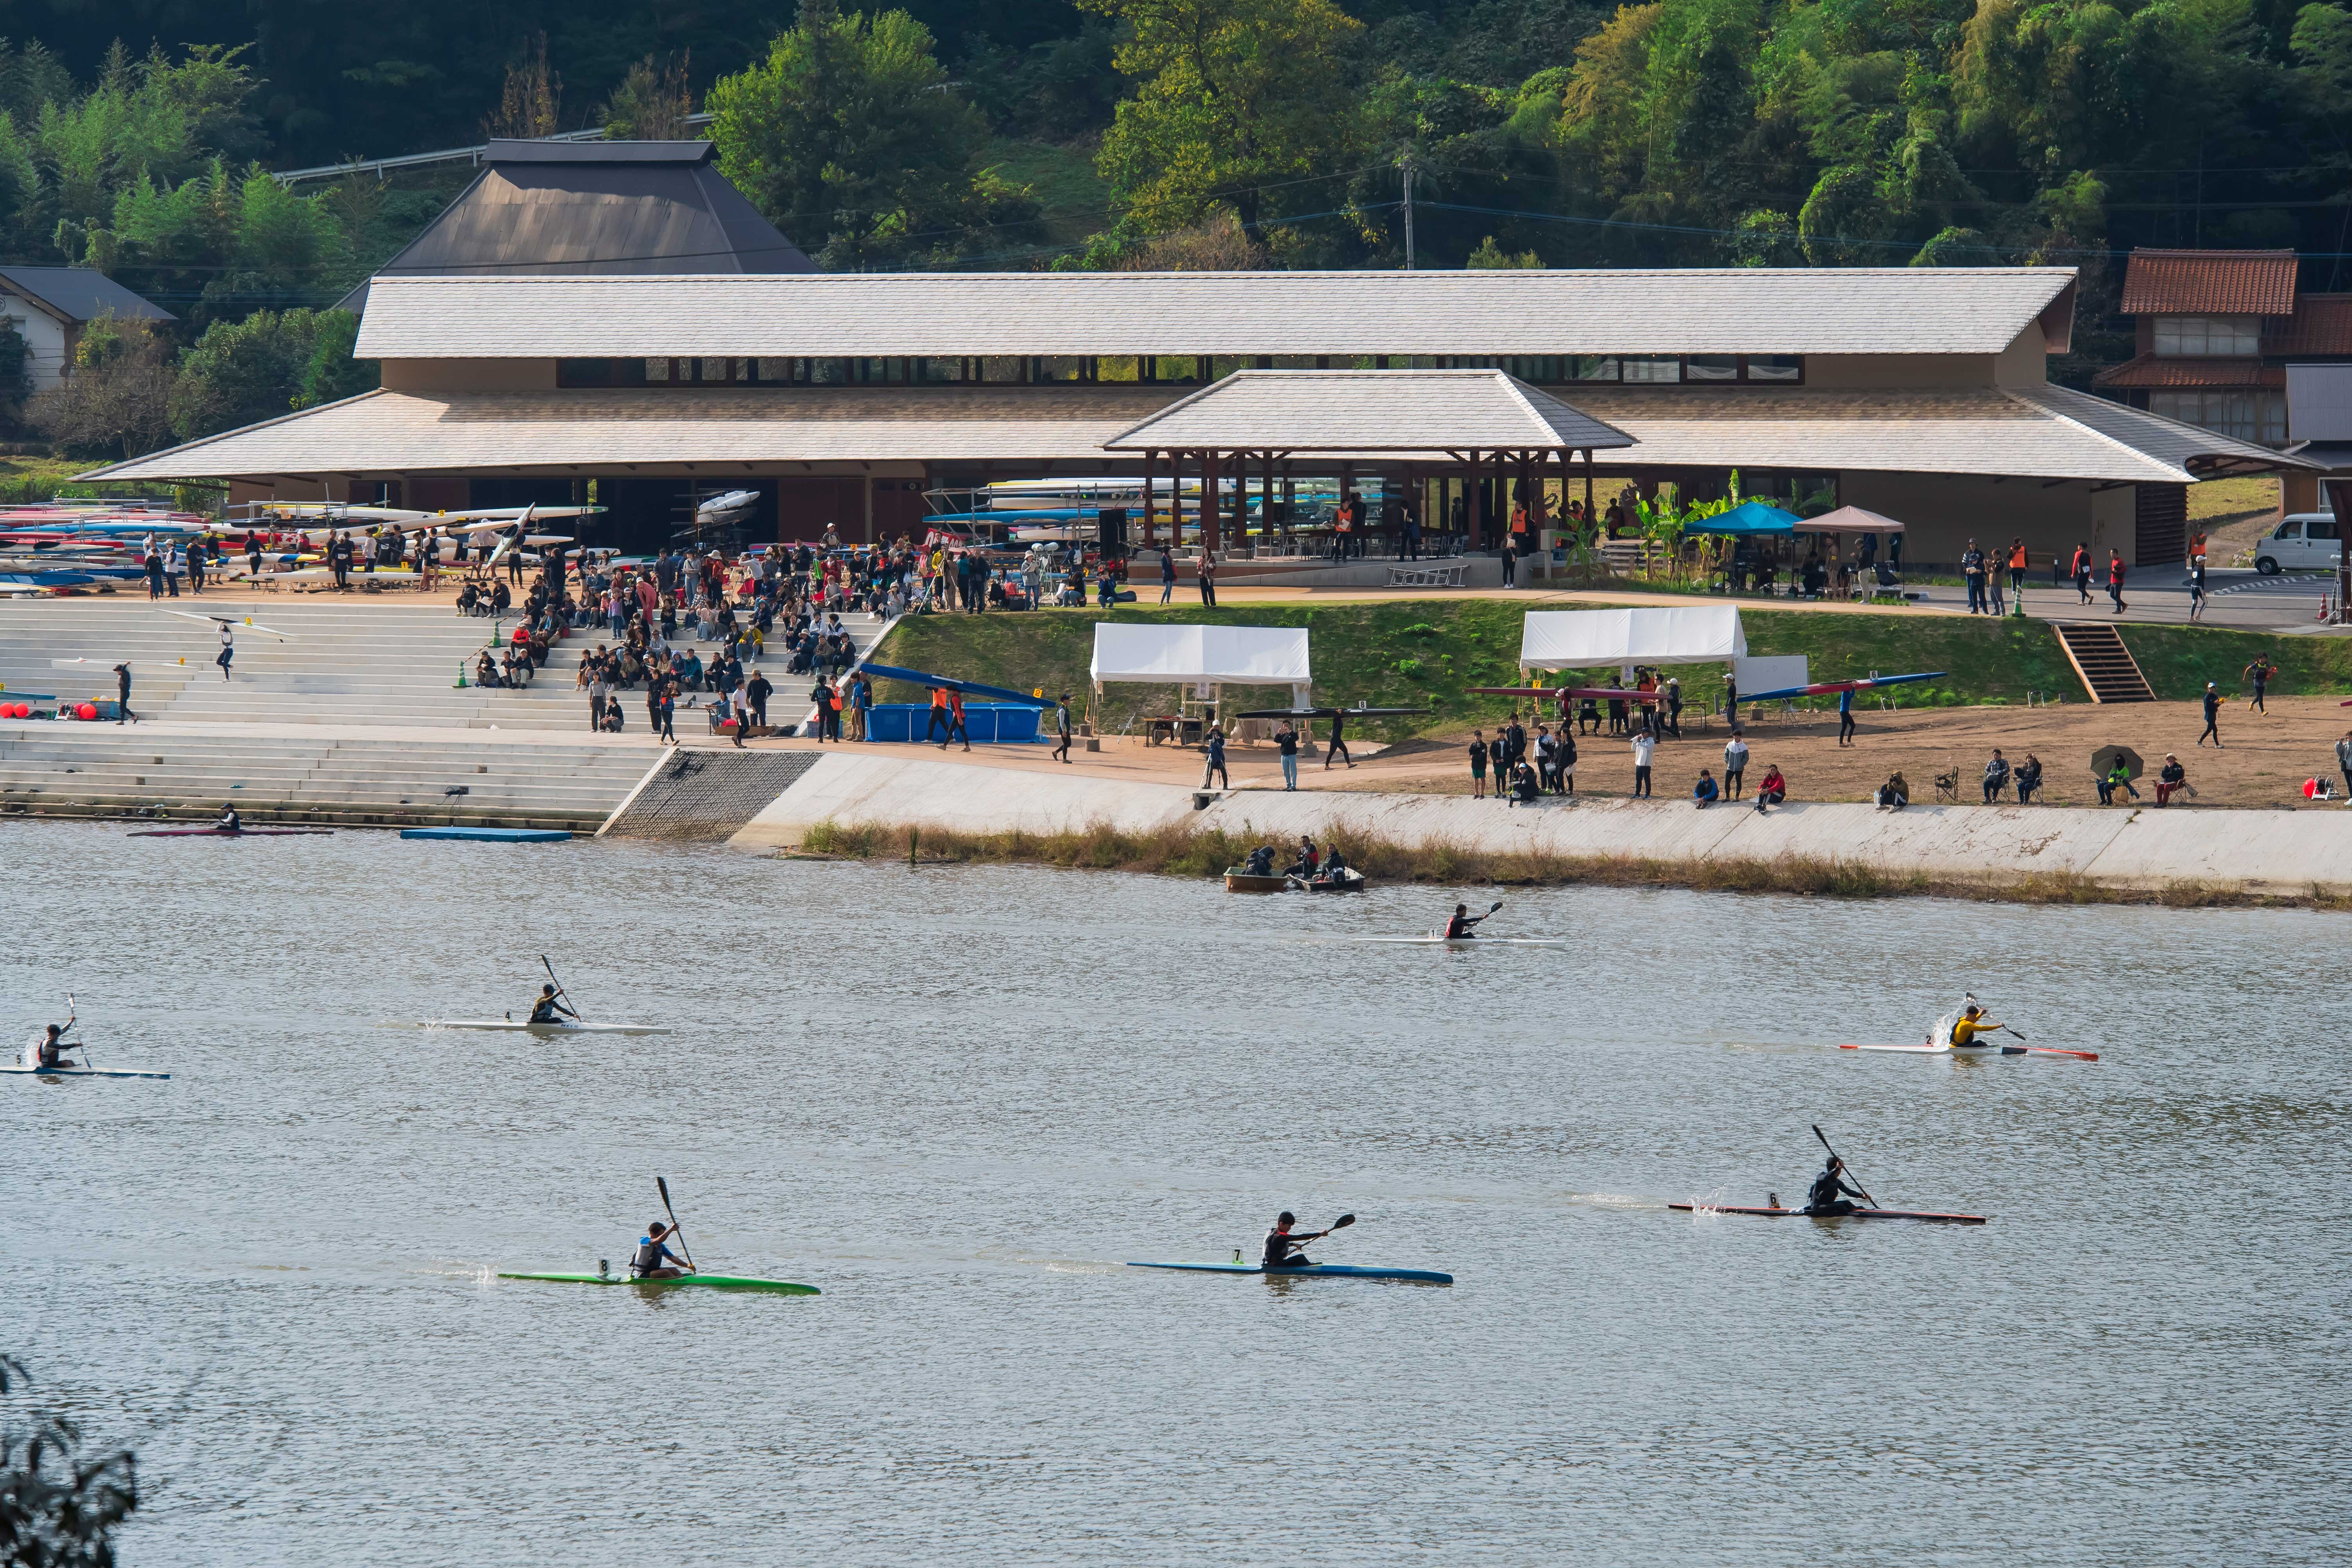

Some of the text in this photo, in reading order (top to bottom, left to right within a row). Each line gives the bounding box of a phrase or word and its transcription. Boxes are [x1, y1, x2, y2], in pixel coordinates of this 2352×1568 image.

[505, 1011, 510, 1020] 4
[1926, 1035, 1931, 1044] 2
[17, 1055, 21, 1064] 5
[1770, 1193, 1777, 1204] 6
[1235, 1249, 1240, 1261] 7
[601, 1259, 607, 1272] 8
